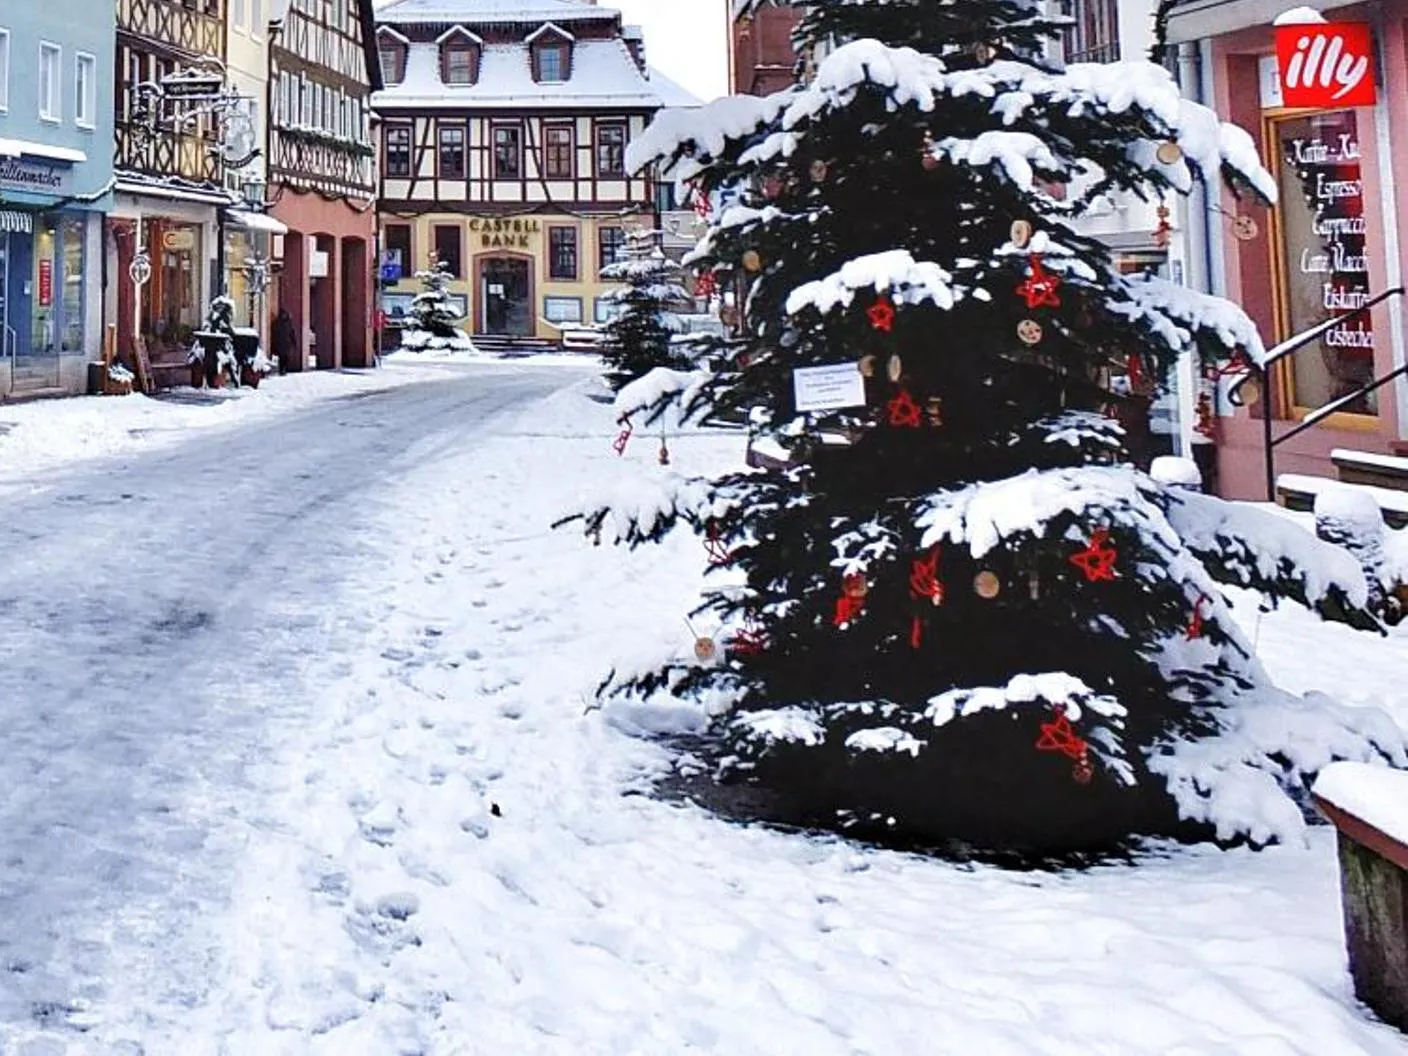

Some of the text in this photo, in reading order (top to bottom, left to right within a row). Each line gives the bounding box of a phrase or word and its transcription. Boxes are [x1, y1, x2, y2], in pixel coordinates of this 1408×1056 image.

[1286, 33, 1368, 100] illy
[469, 219, 539, 232] CASTELL
[482, 234, 529, 247] BANK
